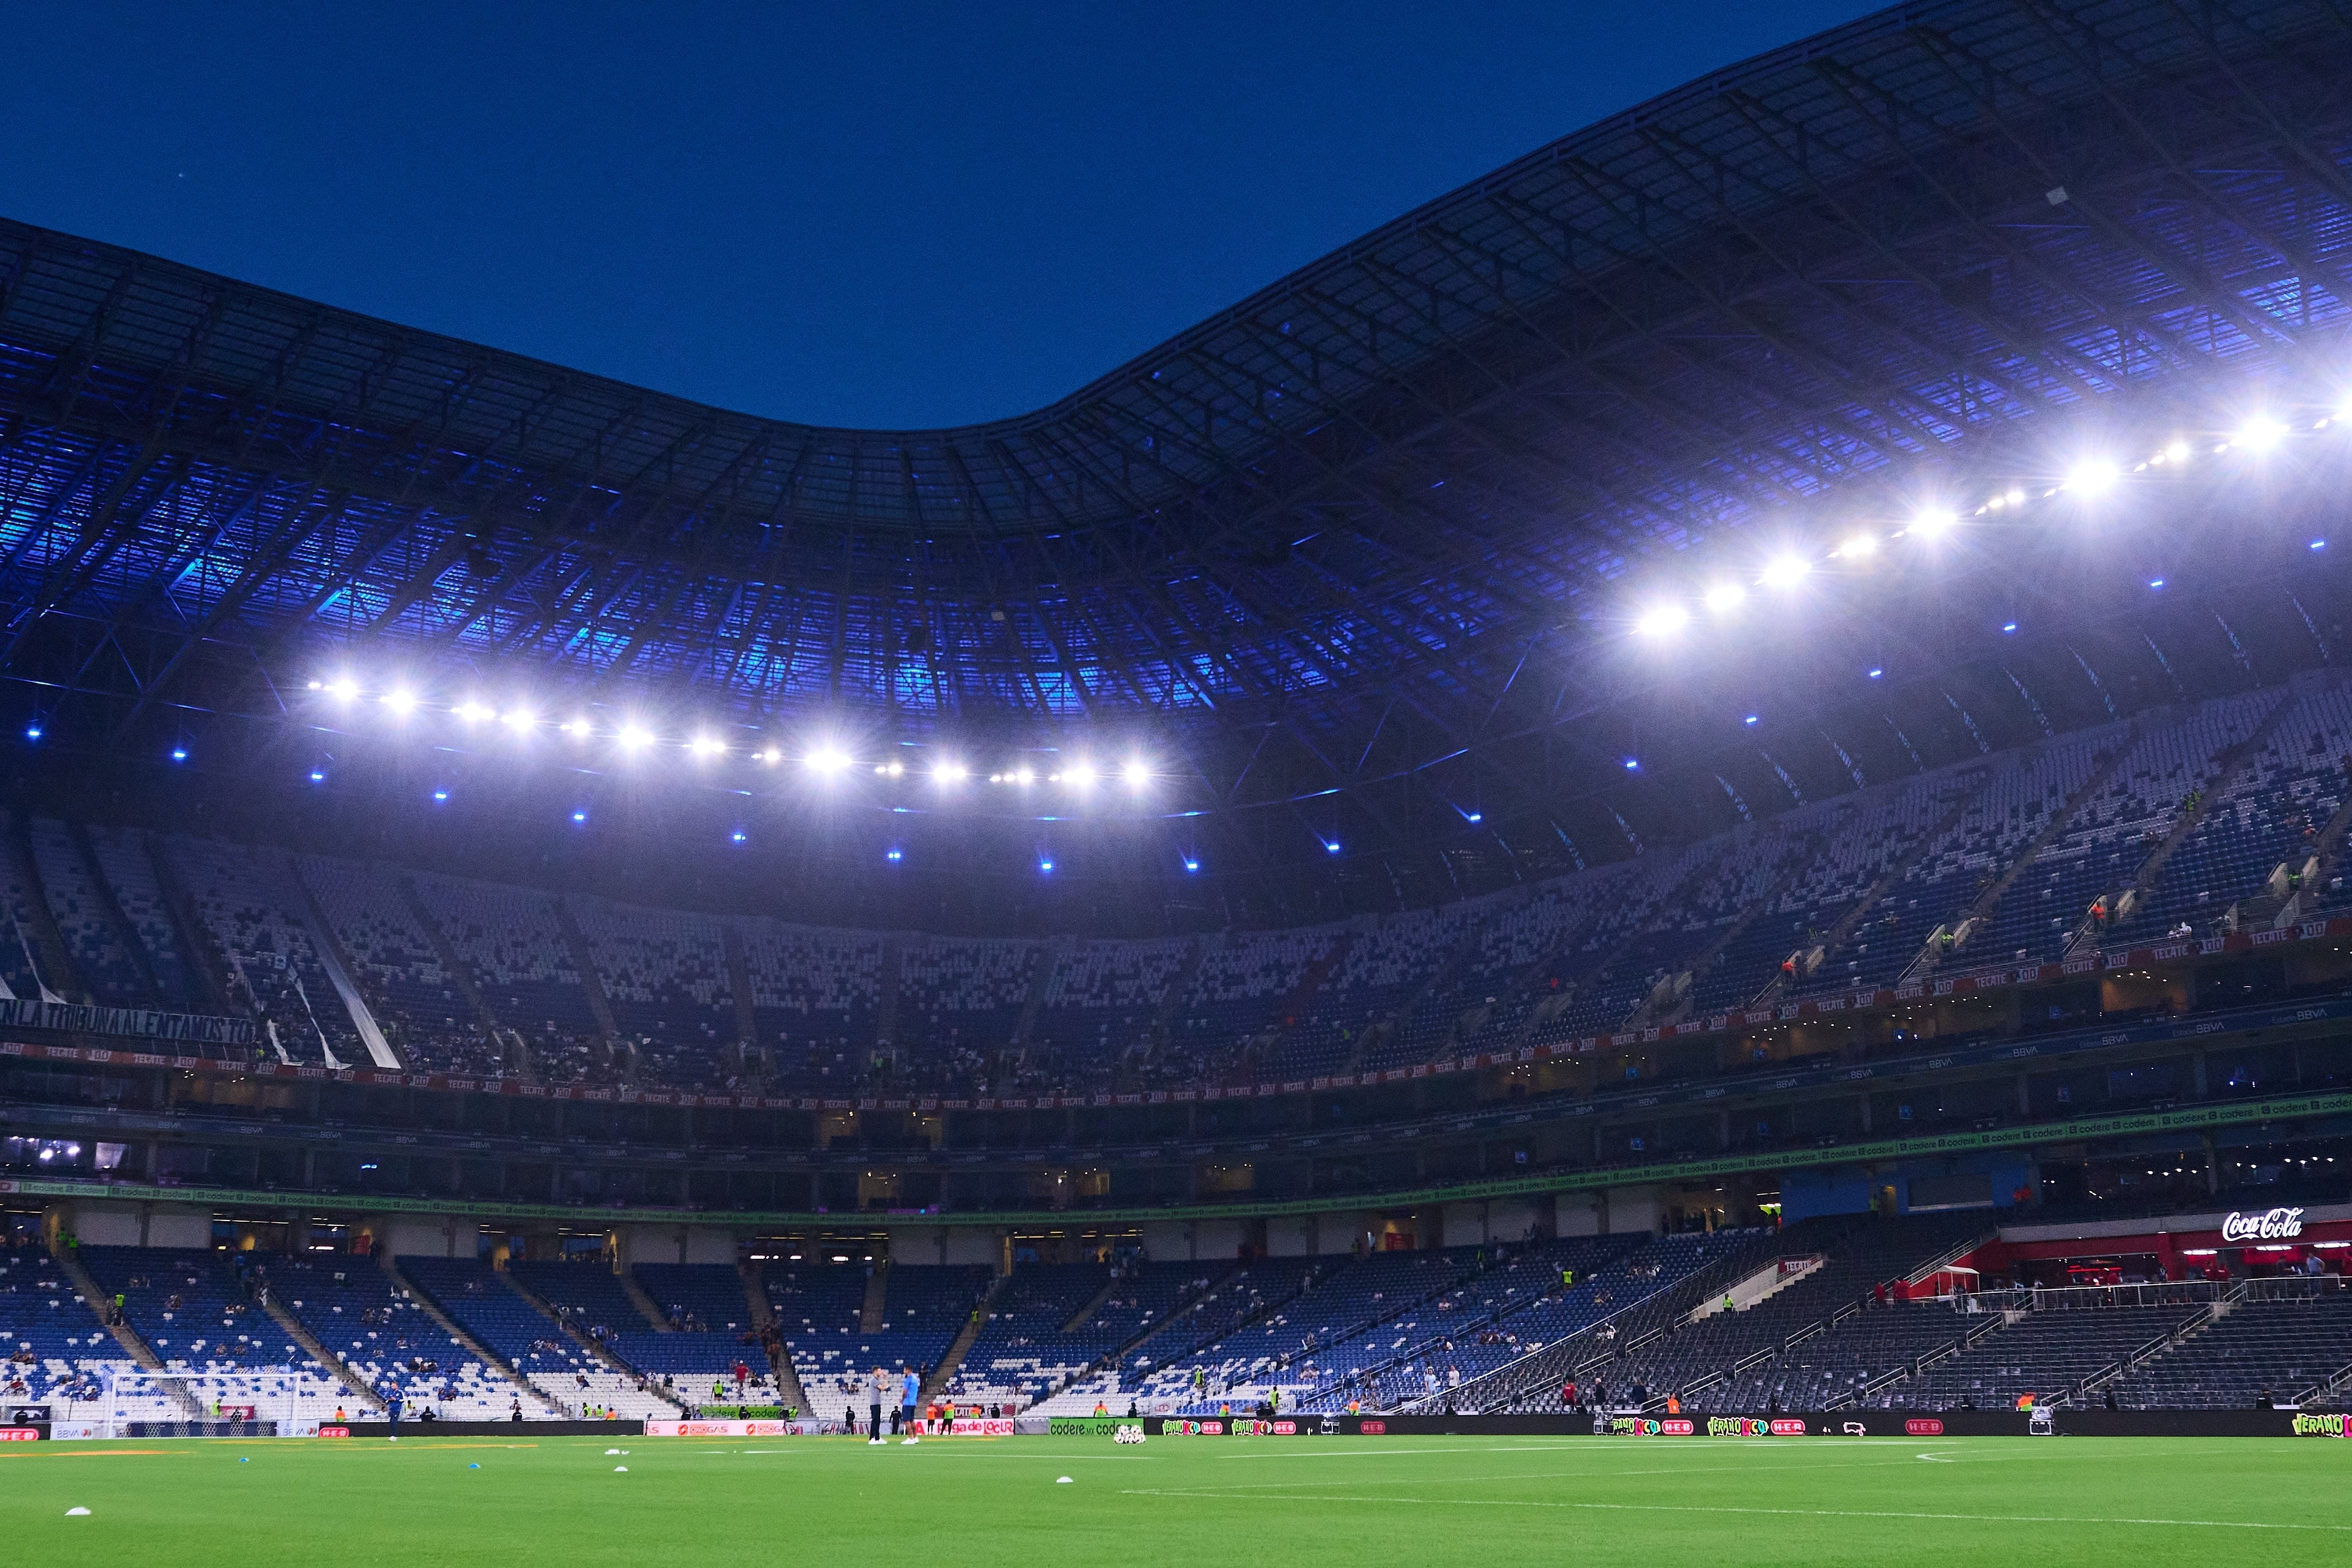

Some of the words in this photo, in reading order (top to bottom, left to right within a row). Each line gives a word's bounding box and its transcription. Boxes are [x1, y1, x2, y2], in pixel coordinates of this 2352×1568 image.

[2250, 928, 2286, 945] TECATE
[2154, 944, 2187, 960] TECATE
[2061, 959, 2094, 975] TECATE
[1976, 973, 2006, 988] TECATE
[1893, 986, 1923, 1001] TECATE
[1819, 998, 1845, 1012] TECATE
[1746, 1009, 1772, 1023] TECATE
[2297, 1008, 2327, 1021] BBVA
[1676, 1021, 1700, 1034] TECATE
[2196, 1021, 2224, 1034] BBVA
[1612, 1032, 1636, 1045] TECATE
[2102, 1034, 2128, 1046] BBVA
[45, 1047, 78, 1057] TECATE
[1551, 1042, 1572, 1054] TECATE
[2013, 1046, 2038, 1057] BBVA
[133, 1054, 164, 1064] TECATE
[1929, 1057, 1953, 1068] BBVA
[216, 1060, 245, 1071] TECATE
[298, 1068, 325, 1078] TECATE
[375, 1074, 400, 1084] TECATE
[1850, 1068, 1872, 1079] BBVA
[449, 1079, 474, 1089] TECATE
[1776, 1078, 1797, 1088] BBVA
[1706, 1088, 1725, 1098] BBVA
[1639, 1096, 1658, 1106] BBVA
[2323, 1097, 2352, 1109] coder
[1575, 1105, 1593, 1115] BBVA
[2220, 1107, 2253, 1119] codere
[2273, 1101, 2307, 1114] codere
[2123, 1117, 2154, 1129] codere
[2173, 1112, 2205, 1124] codere
[2033, 1127, 2062, 1139] codere
[2080, 1121, 2109, 1134] codere
[1947, 1136, 1975, 1147] codere
[1992, 1132, 2020, 1143] codere
[1867, 1145, 1893, 1155] codere
[1909, 1139, 1936, 1151] codere
[1792, 1152, 1816, 1162] codere
[1830, 1149, 1856, 1158] codere
[1720, 1160, 1743, 1170] codere
[1757, 1156, 1780, 1166] codere
[1687, 1164, 1710, 1174] codere
[2222, 1207, 2304, 1242] Coca-Cola
[968, 1420, 981, 1431] de
[1162, 1419, 1183, 1435] VERANO
[1231, 1419, 1254, 1435] VERANO
[1635, 1418, 1658, 1436] LOCO
[1708, 1417, 1740, 1436] VERANO
[1740, 1417, 1765, 1436] LOCO
[2292, 1413, 2343, 1435] VERANO
[57, 1430, 79, 1438] BBVA
